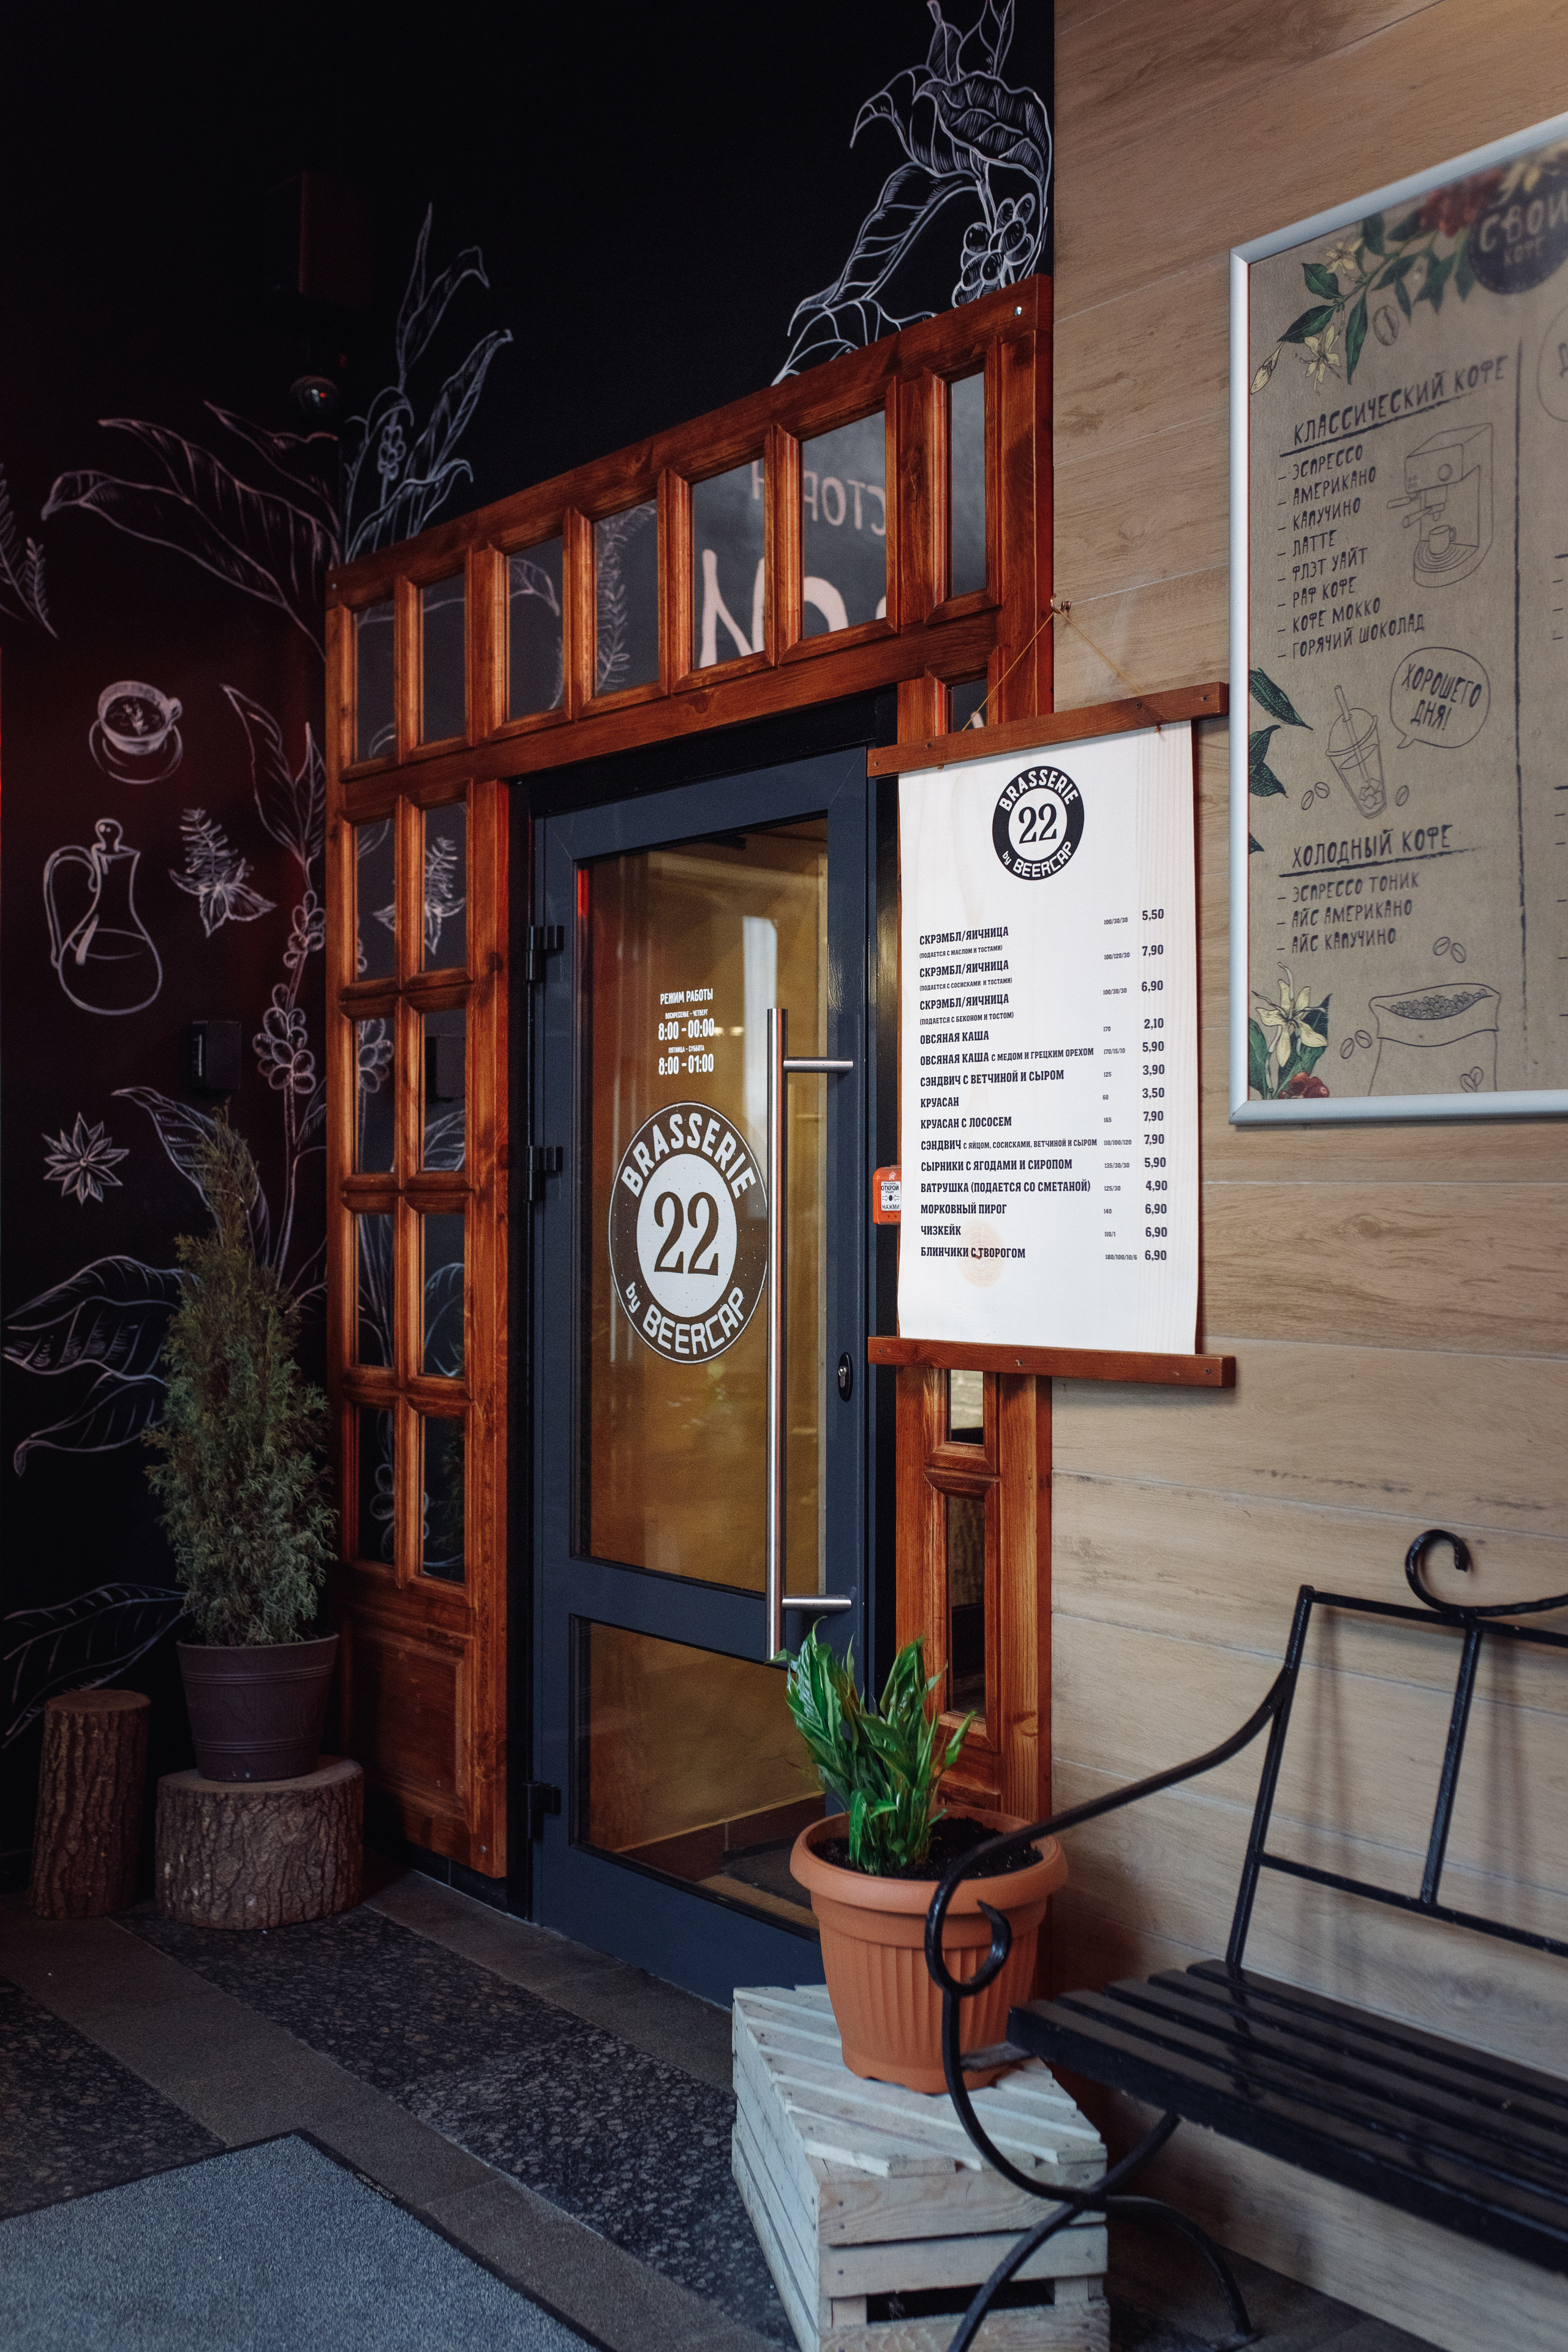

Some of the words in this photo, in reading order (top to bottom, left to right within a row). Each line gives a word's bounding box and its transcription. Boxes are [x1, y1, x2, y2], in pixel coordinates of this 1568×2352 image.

[1295, 370, 1444, 446] КЛАССИЧЕСКИЙ
[1455, 356, 1508, 392] КОФЕ
[1292, 445, 1363, 480] ЭСПРЕССО
[1294, 467, 1376, 505] АМЕРИКАНО
[1294, 497, 1361, 531] КАПУЧИНО
[1292, 530, 1337, 557] ЛАТТЕ
[1292, 559, 1327, 582] ФЛЭТ
[1332, 546, 1368, 571] УАЙТ
[1293, 587, 1316, 608] РАФ
[1323, 576, 1357, 600] КОФЕ
[1293, 611, 1327, 633] КОФЕ
[1332, 597, 1381, 624] МОККО
[1293, 627, 1352, 659] ГОРЯЧИЙ
[1359, 614, 1425, 643] ШОКОЛАД
[1402, 663, 1482, 708] ХОРОШЕГО
[1411, 699, 1452, 731] ДНЯ!
[998, 769, 1079, 812] BRASSERIE
[1018, 803, 1057, 844] 22
[1292, 828, 1392, 868] ХОЛОДНЫЙ
[1402, 825, 1453, 853] КОФЕ
[1002, 851, 1012, 865] by
[1012, 841, 1072, 878] BEERCAP
[1292, 879, 1363, 903] ЭСПРЕССО
[1369, 872, 1420, 892] ТОНИК
[1142, 909, 1164, 921] 5,50
[1291, 905, 1319, 929] АЙС
[1324, 899, 1413, 924] АМЕРИКАНО
[920, 927, 1009, 945] СКРЭМБЛ/ЯИЧНИЦА
[1291, 932, 1319, 954] АЙС
[1325, 928, 1396, 951] КАПУЧИНО
[1142, 944, 1163, 957] 7,90
[920, 960, 1009, 978] СКРЭМБЛ/ЯИЧНИЦА
[1142, 980, 1163, 993] 6,90
[660, 991, 684, 1005] РЕЖИМ
[686, 989, 713, 1002] РАБОТЫ
[920, 994, 1009, 1010] СКРЭМБЛ/ЯИЧНИЦА
[665, 1011, 689, 1019] ВОСКРЕСЕНЬЕ
[920, 1017, 950, 1025] (ПОДАЕТСЯ
[989, 1011, 1014, 1020] ТОСТОМ)
[658, 1021, 679, 1041] 8:00
[688, 1018, 714, 1038] 00:00
[1144, 1018, 1164, 1030] 2,10
[921, 1033, 960, 1044] ОВСЯНАЯ
[962, 1031, 989, 1041] КАША
[1143, 1041, 1164, 1053] 5,90
[658, 1056, 679, 1075] 8:00
[688, 1054, 714, 1073] 01:00
[921, 1054, 960, 1066] ОВСЯНАЯ
[962, 1052, 989, 1063] КАША
[997, 1052, 1022, 1061] МЕДОМ
[1031, 1050, 1063, 1059] ГРЕЦКИМ
[1066, 1048, 1093, 1057] ОРЕХОМ
[921, 1076, 960, 1087] СЭНДВИЧ
[963, 1075, 968, 1084] С
[971, 1070, 1018, 1084] ВЕТЧИНОЙ
[1020, 1072, 1027, 1082] И
[1029, 1069, 1064, 1081] СЫРОМ
[1143, 1065, 1164, 1076] 3,90
[921, 1097, 959, 1107] КРУАСАН
[1142, 1088, 1164, 1099] 3,50
[921, 1118, 959, 1129] КРУАСАН
[962, 1118, 967, 1128] С
[969, 1117, 1012, 1127] ЛОСОСЕМ
[1144, 1110, 1164, 1122] 7,90
[921, 1140, 961, 1151] СЭНДВИЧ
[968, 1141, 991, 1150] ЯЙЦОМ,
[1034, 1139, 1066, 1147] ВЕТЧИНОЙ
[1144, 1134, 1164, 1145] 7,90
[620, 1112, 756, 1199] BRASSERIE
[1145, 1157, 1166, 1169] 5,90
[921, 1161, 963, 1171] СЫРНИКИ
[966, 1161, 971, 1170] С
[973, 1160, 1017, 1172] ЯГОДАМИ
[1019, 1160, 1025, 1170] И
[1028, 1159, 1072, 1169] СИРОПОМ
[921, 1183, 969, 1193] ВАТРУШКА
[971, 1182, 1021, 1193] (ПОДАЕТСЯ
[1024, 1182, 1035, 1192] СО
[1038, 1179, 1090, 1192] СМЕТАНОЙ)
[1146, 1180, 1167, 1192] 4,90
[921, 1202, 976, 1214] МОРКОВНЫЙ
[979, 1204, 1007, 1214] ПИРОГ
[1145, 1204, 1167, 1215] 6,90
[654, 1191, 718, 1276] 22
[921, 1224, 961, 1235] ЧИЗКЕЙК
[1145, 1227, 1167, 1238] 6,90
[921, 1247, 969, 1257] БЛИНЧИКИ
[971, 1248, 976, 1258] С
[978, 1248, 1025, 1258] ТВОРОГОМ
[1145, 1250, 1167, 1261] 6,90
[625, 1283, 640, 1313] by
[642, 1286, 744, 1355] BEERCAP
